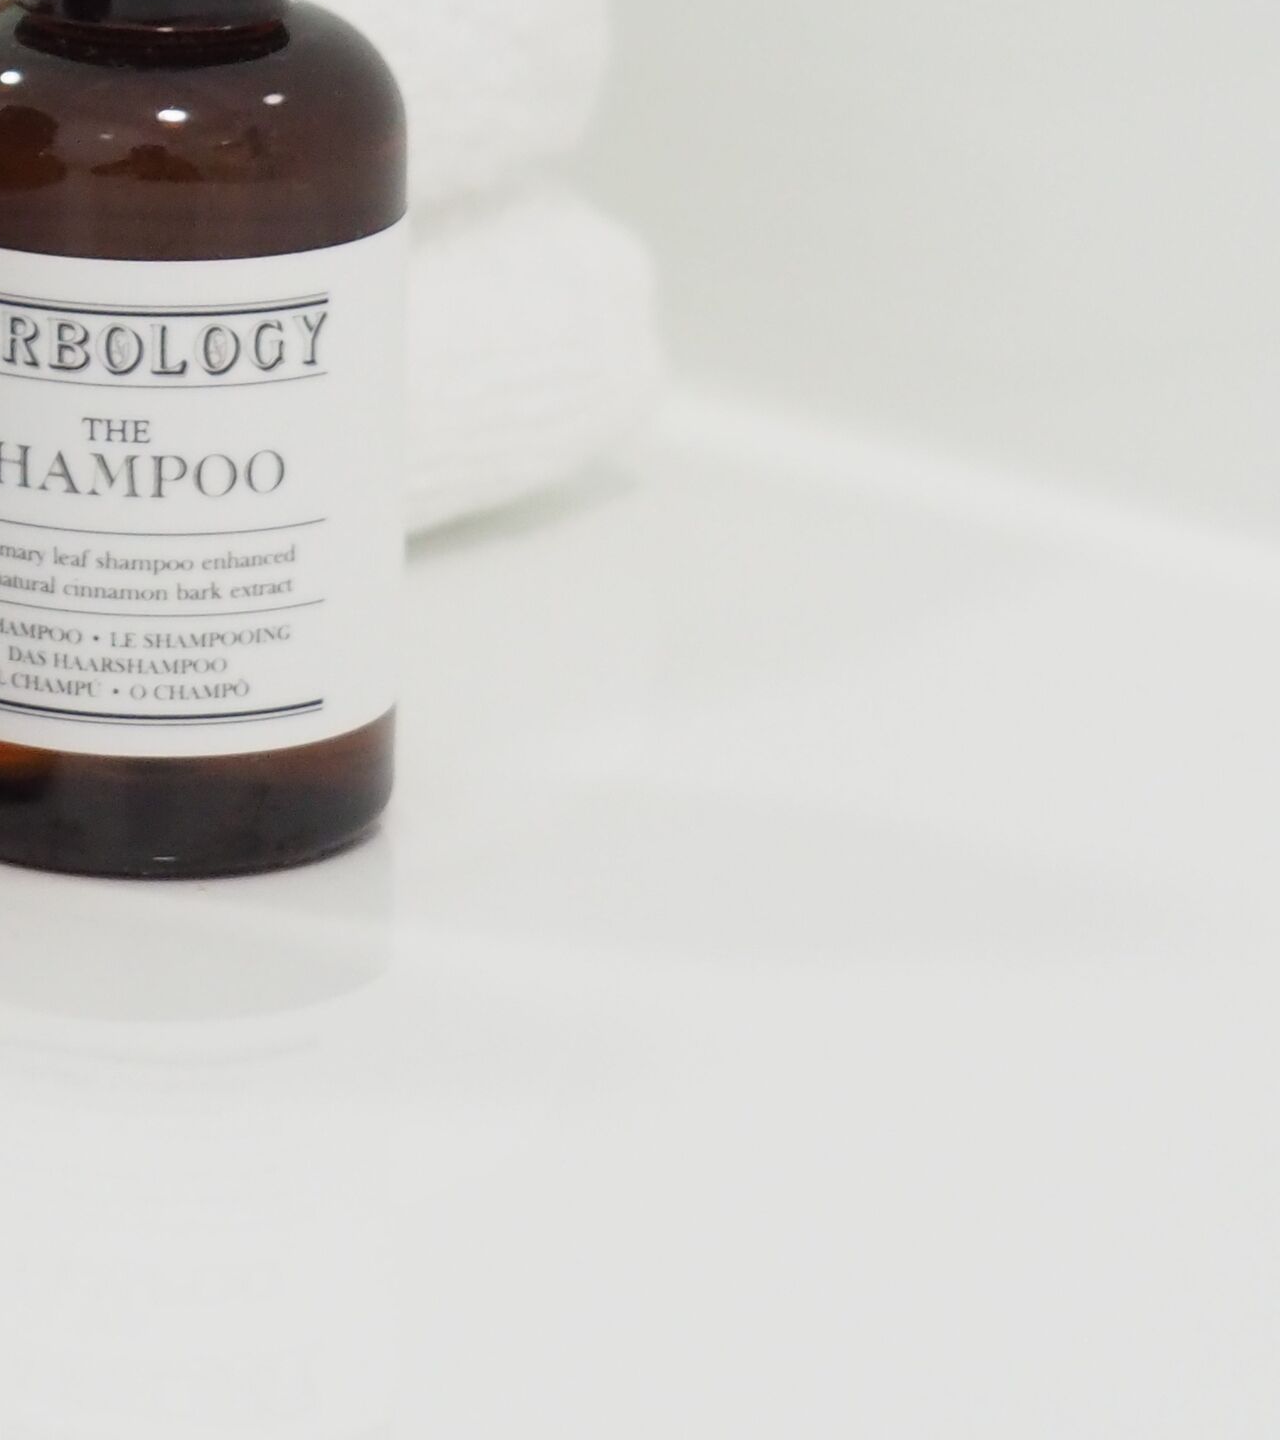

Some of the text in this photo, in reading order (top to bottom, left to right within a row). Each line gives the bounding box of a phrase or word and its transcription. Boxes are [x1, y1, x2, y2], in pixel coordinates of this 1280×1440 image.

[82, 417, 152, 444] THE
[53, 546, 91, 567] leaf
[96, 550, 194, 575] shampoo
[202, 543, 296, 571] enhanced
[63, 578, 168, 601] cinnamon
[177, 581, 222, 601] bark
[230, 578, 293, 599] extract
[110, 632, 137, 648] LE
[144, 625, 291, 648] SHAMPOOING
[8, 645, 228, 675] DAS HAARSHAMPOO
[130, 683, 147, 701] O
